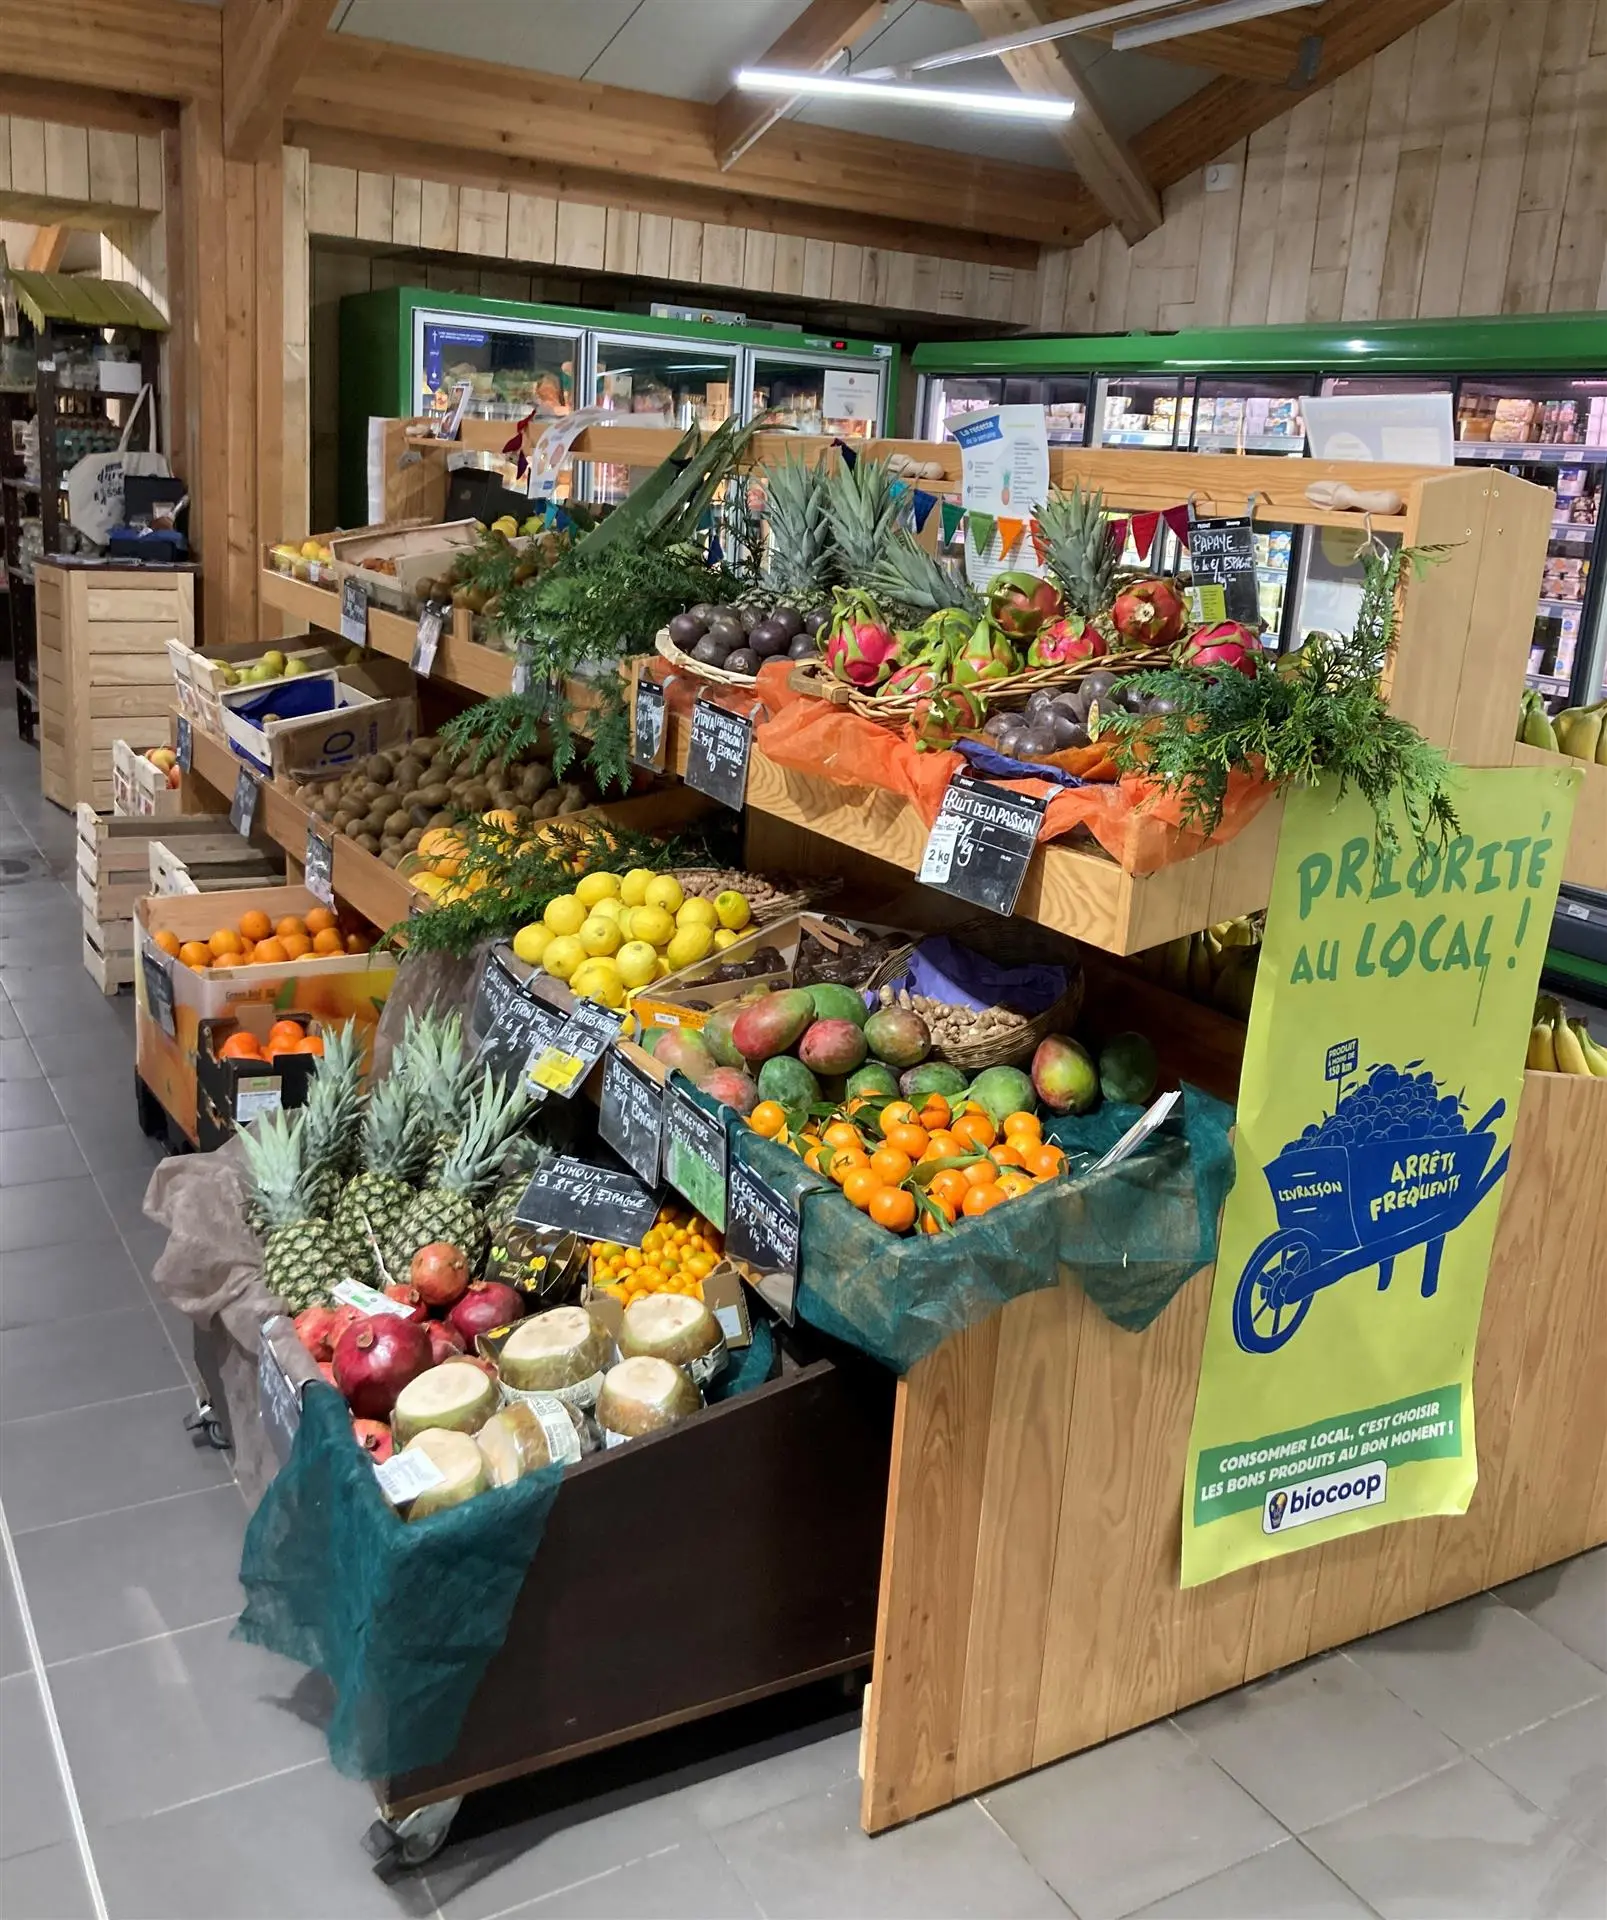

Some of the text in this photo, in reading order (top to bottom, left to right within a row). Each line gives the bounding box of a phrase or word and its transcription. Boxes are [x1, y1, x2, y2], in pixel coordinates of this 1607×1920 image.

[1193, 533, 1234, 553] PAPAYE
[996, 808, 1040, 836] PASSION
[928, 849, 950, 865] 2 kg
[1297, 811, 1553, 920] PRIORITÉ
[1290, 940, 1340, 984] AU
[1355, 914, 1494, 979] LOCAL
[613, 1061, 650, 1108] ALOE VERA
[552, 1161, 618, 1184] KUMQUAT
[1391, 1150, 1456, 1188] ARRÊTS
[1279, 1181, 1343, 1202] LIVRAISON
[1370, 1175, 1461, 1222] FRÉQUENTS
[1219, 1401, 1440, 1473] CONSOMMER LOCAL, C'EST CHOISIR
[1201, 1420, 1454, 1502] LES BONS PRODUITS AU BON MOMENT !
[1290, 1473, 1382, 1514] biocoop
